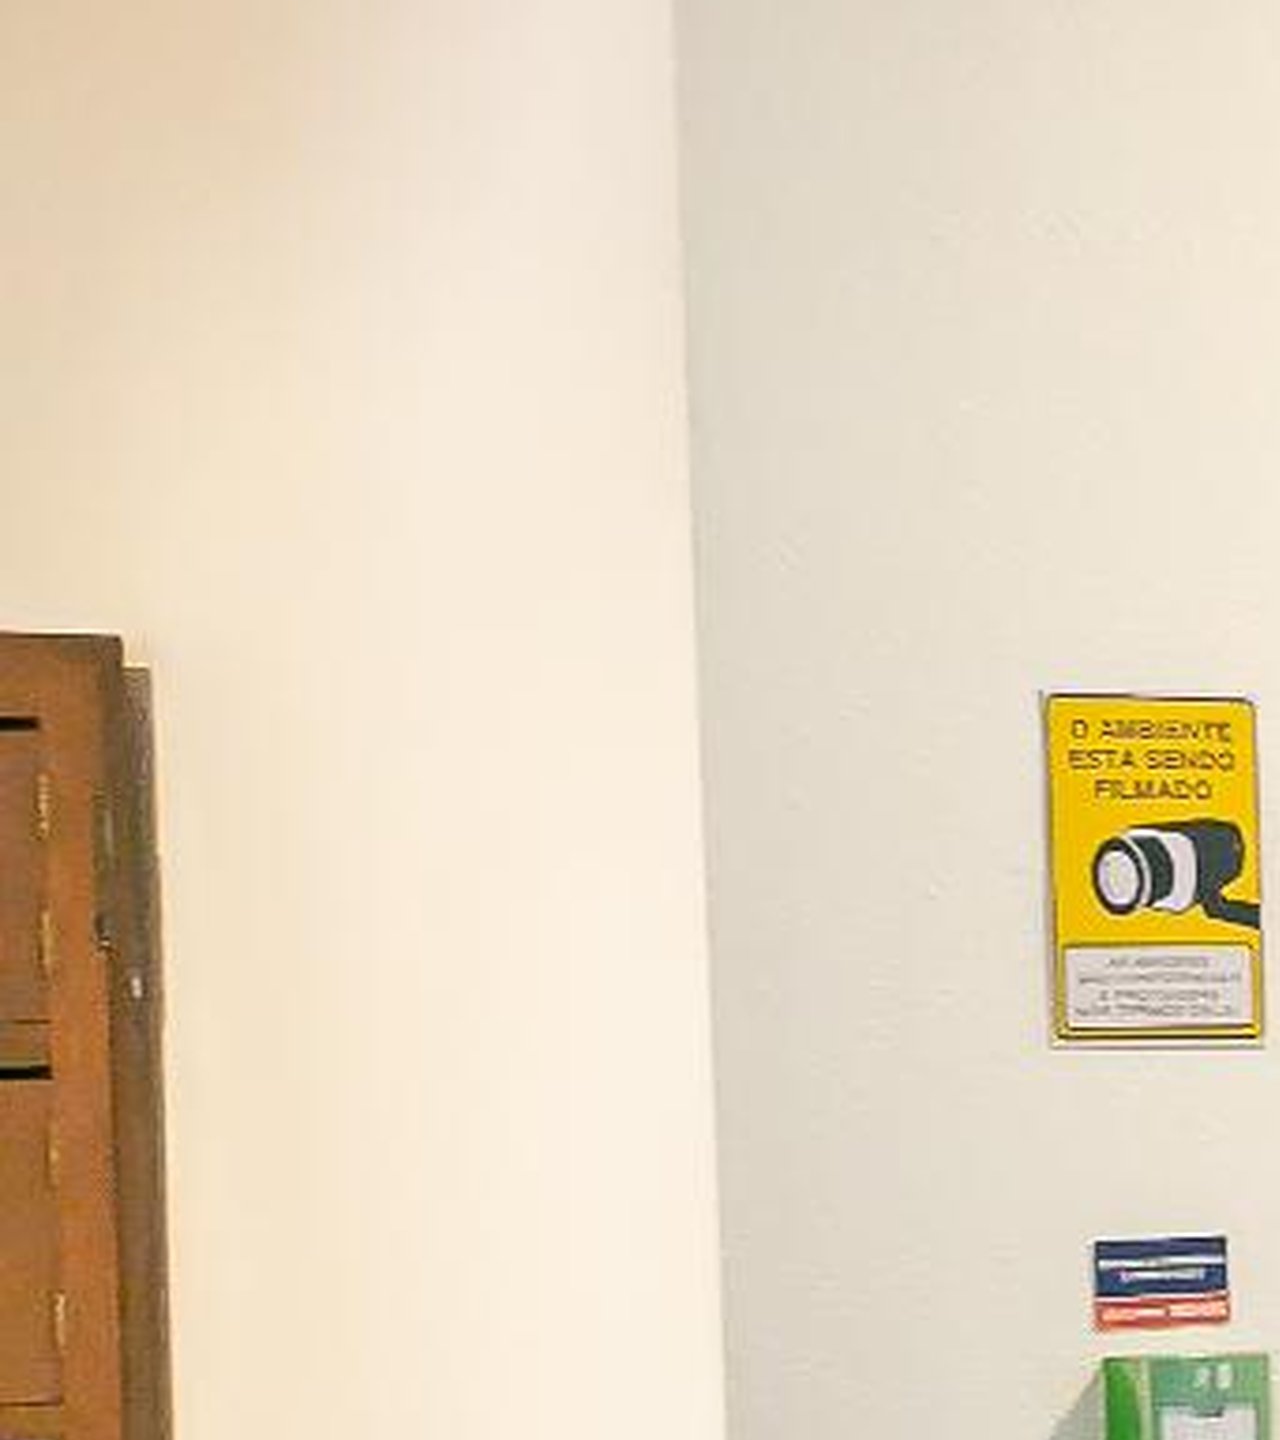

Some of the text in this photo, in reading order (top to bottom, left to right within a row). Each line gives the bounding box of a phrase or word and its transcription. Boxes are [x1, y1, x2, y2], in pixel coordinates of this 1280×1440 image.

[1071, 719, 1232, 743] O AMBIENTE
[1144, 749, 1236, 772] SENDO
[1094, 778, 1213, 800] FILMADO
